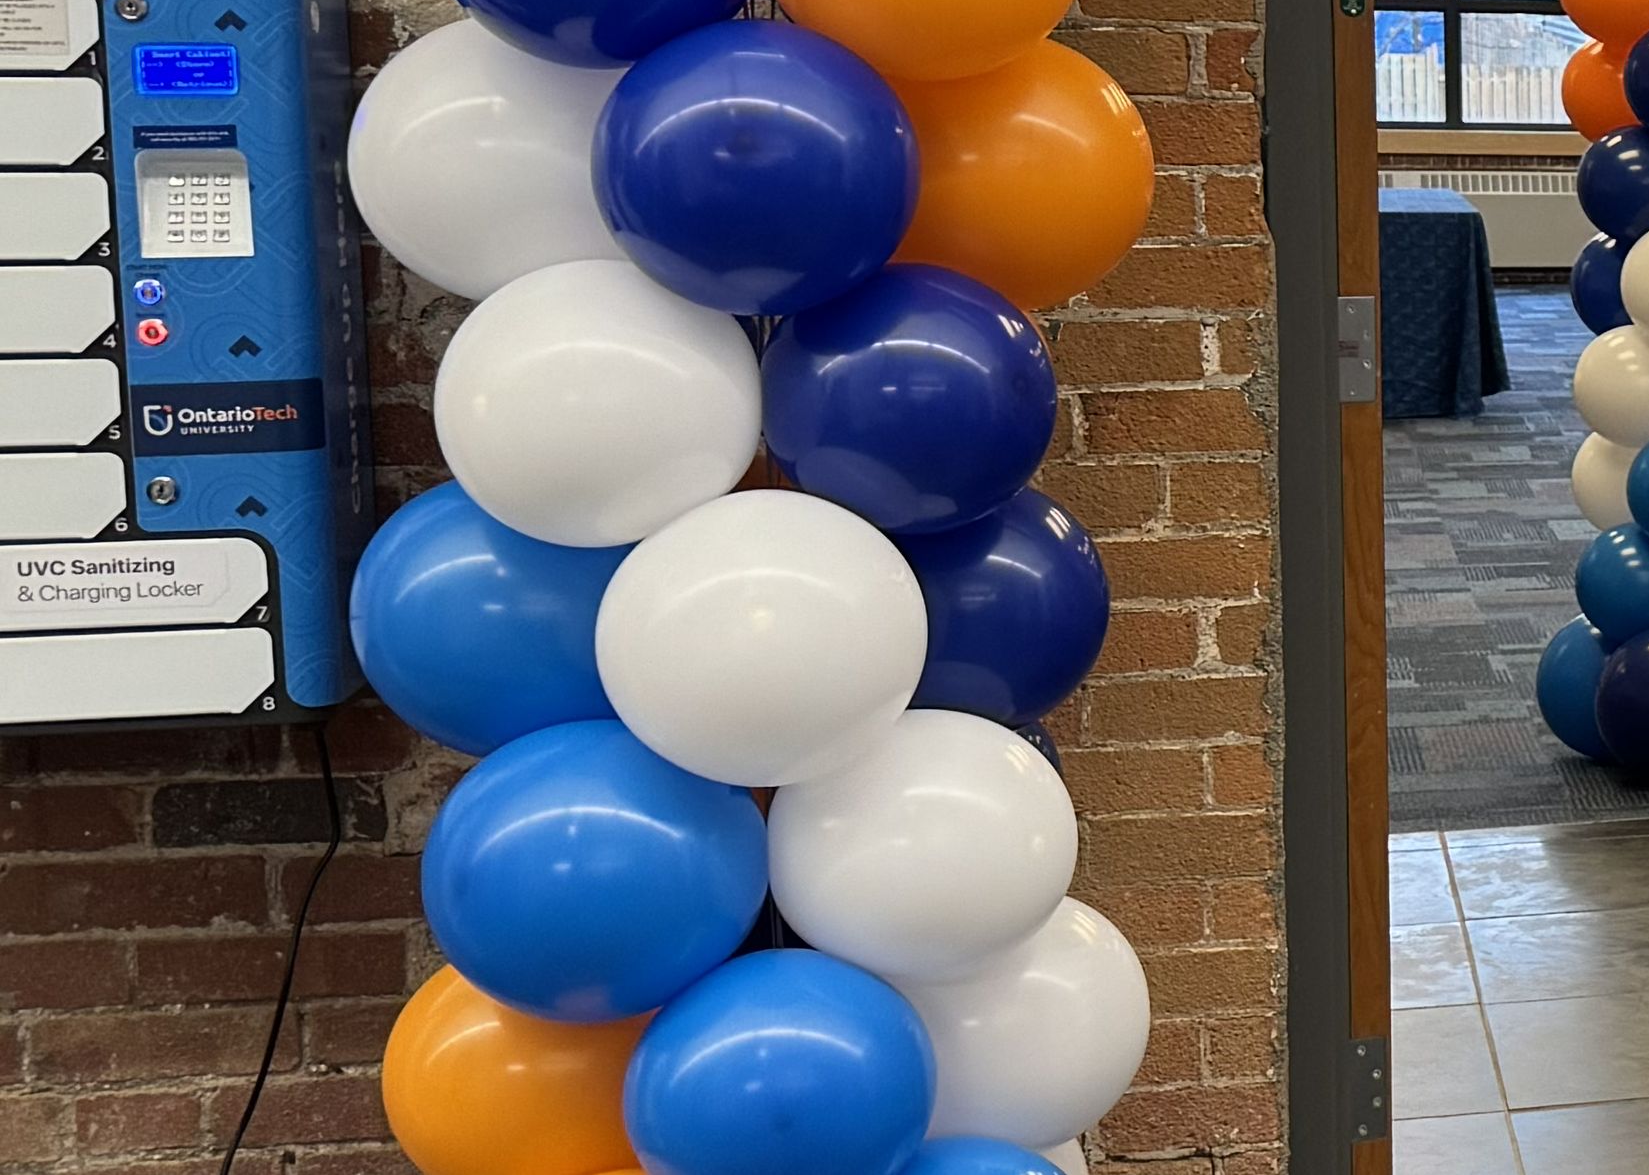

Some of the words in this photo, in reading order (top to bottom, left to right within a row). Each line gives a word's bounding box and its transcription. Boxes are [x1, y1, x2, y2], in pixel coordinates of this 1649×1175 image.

[87, 50, 97, 66] 1
[92, 145, 106, 161] 2
[98, 241, 112, 257] 3
[102, 333, 117, 349] 4
[177, 403, 298, 424] OntarioTech
[108, 424, 122, 440] 5
[179, 425, 255, 436] UNIVERSITY
[114, 516, 128, 533] 6
[16, 560, 66, 577] UVC
[71, 557, 176, 576] Sanitizing
[17, 585, 35, 602] &
[38, 583, 132, 604] Charging
[136, 581, 205, 599] Locker
[256, 606, 270, 622] 7
[262, 696, 276, 712] 8
